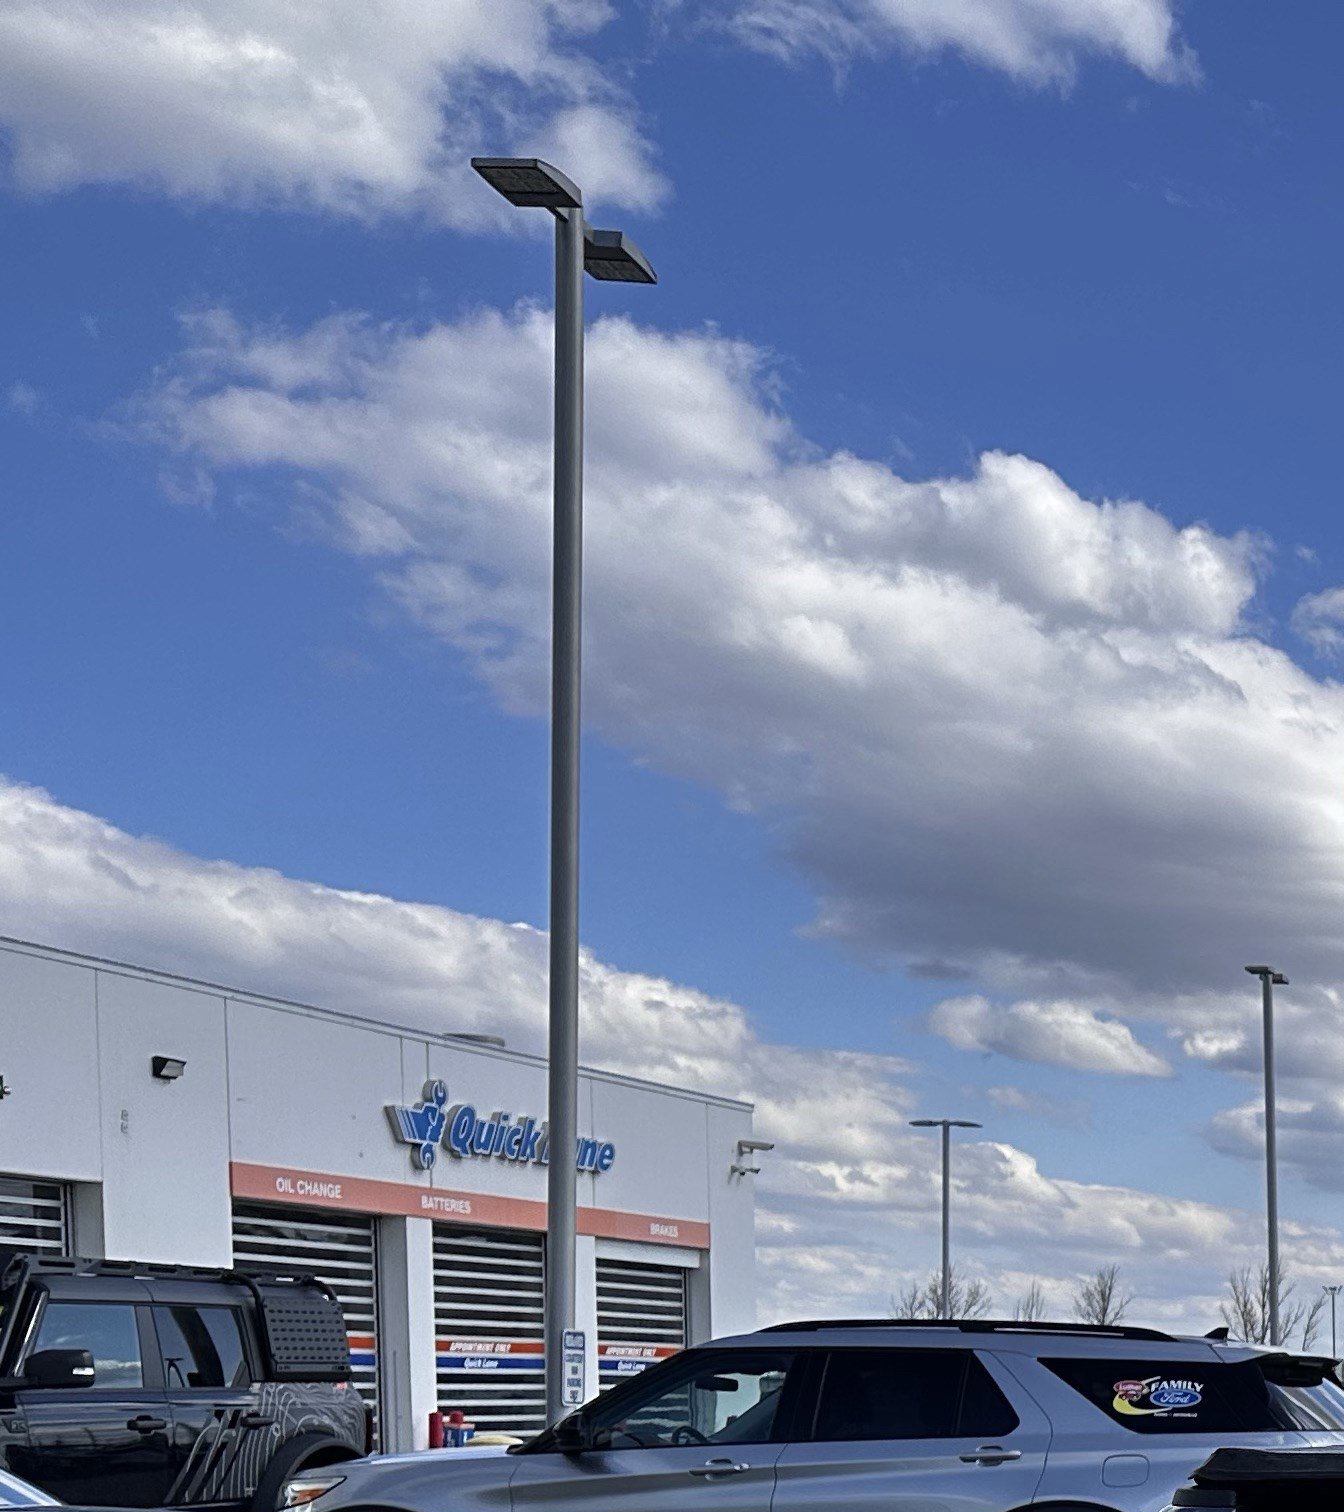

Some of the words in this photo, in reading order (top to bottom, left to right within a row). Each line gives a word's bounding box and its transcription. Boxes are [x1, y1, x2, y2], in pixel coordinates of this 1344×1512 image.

[445, 1104, 541, 1162] Quick
[542, 1121, 616, 1172] ne
[275, 1177, 294, 1194] OIL
[297, 1180, 343, 1199] CHANGE
[421, 1195, 472, 1214] BATTERIES
[1150, 1380, 1204, 1393] FAMILY
[1160, 1391, 1192, 1404] Ford
